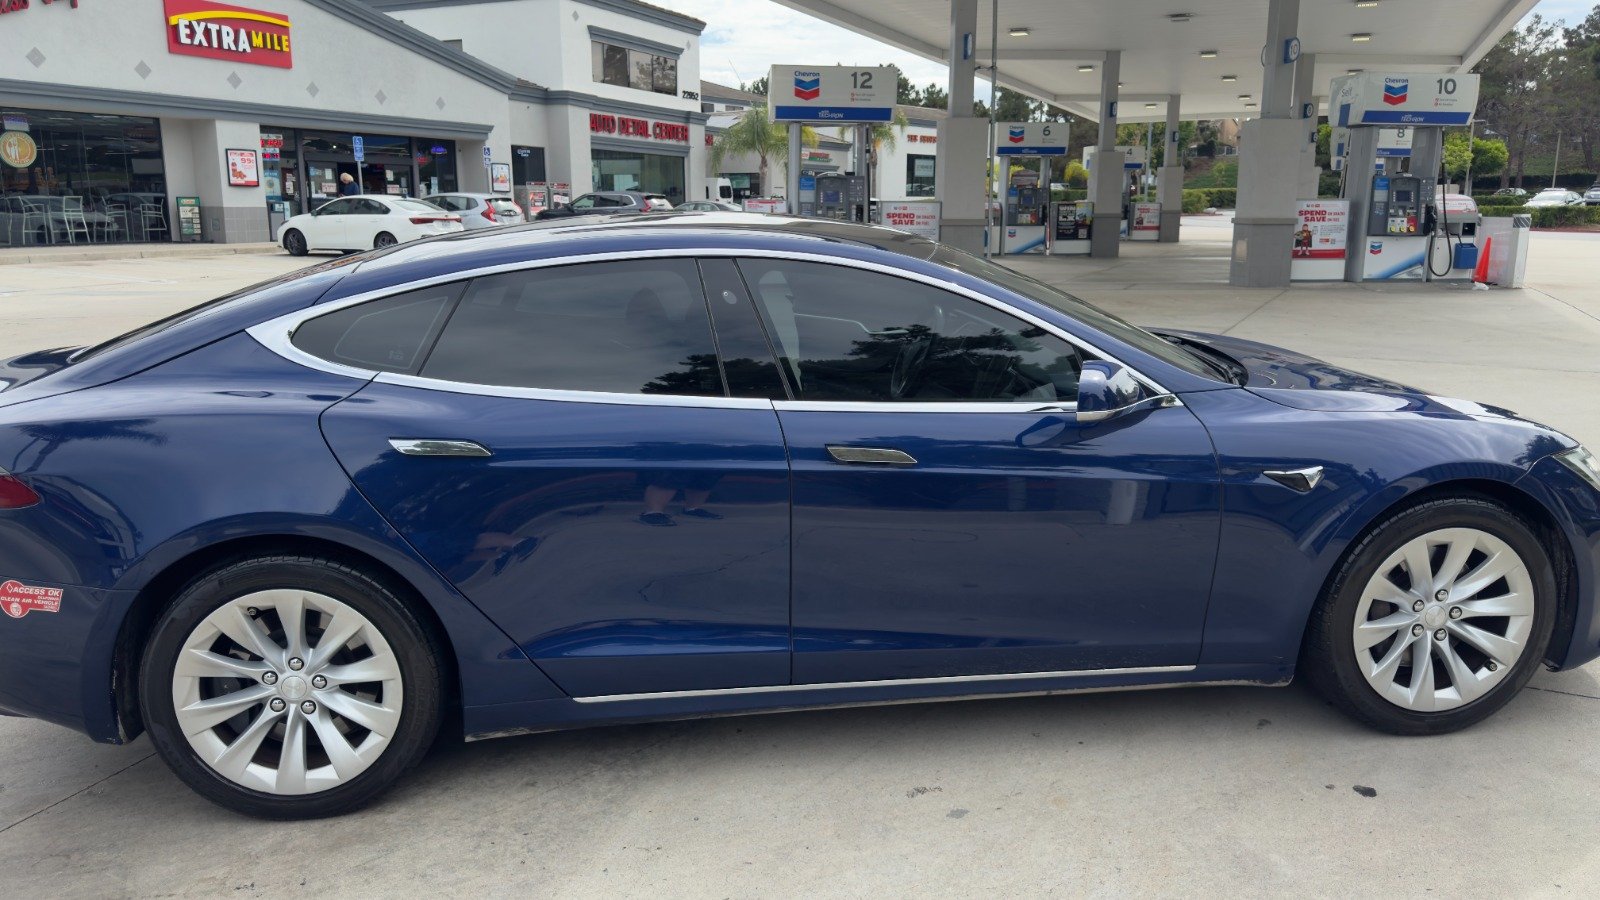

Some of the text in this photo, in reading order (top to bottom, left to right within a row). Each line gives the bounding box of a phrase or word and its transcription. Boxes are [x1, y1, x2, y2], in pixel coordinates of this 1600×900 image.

[850, 71, 873, 90] 12
[1436, 78, 1457, 95] 10
[589, 113, 616, 133] AUTO
[618, 117, 652, 138] DETAIL
[653, 121, 689, 141] CENTER
[1042, 125, 1051, 136] 6
[1397, 128, 1405, 138] 8
[13, 587, 45, 596] ACCESS
